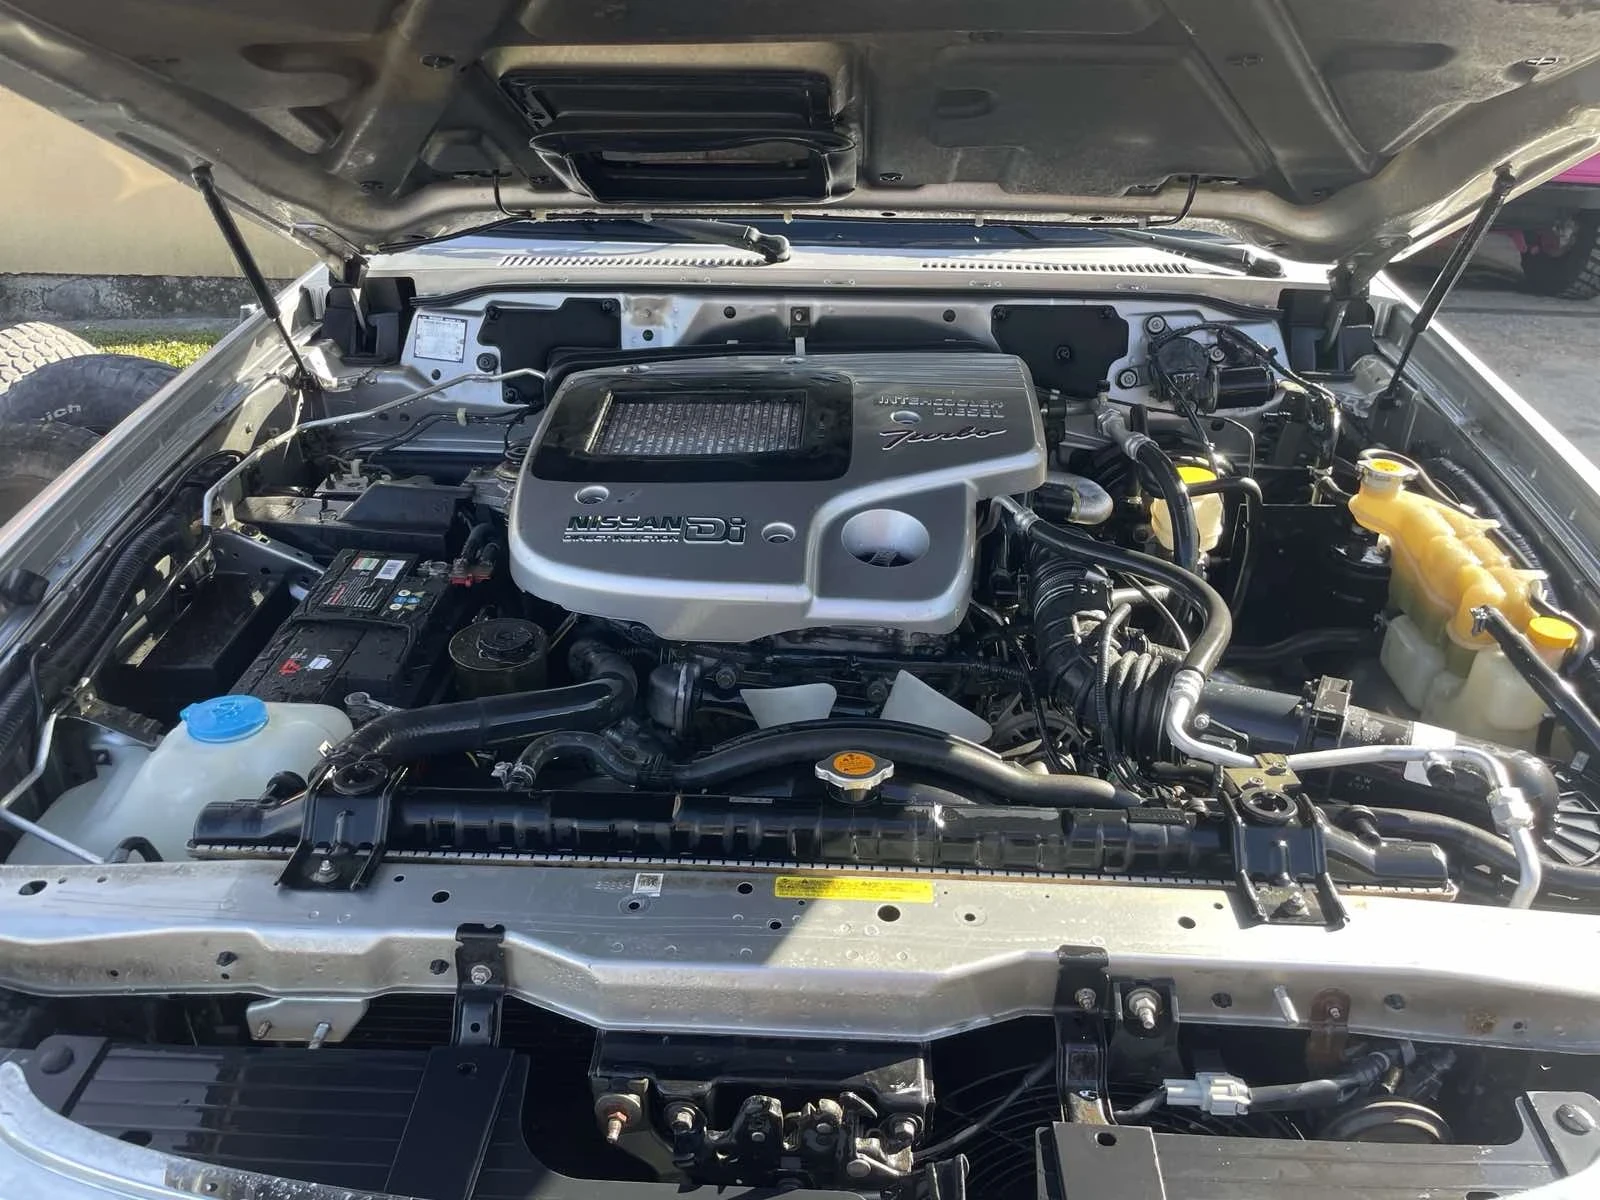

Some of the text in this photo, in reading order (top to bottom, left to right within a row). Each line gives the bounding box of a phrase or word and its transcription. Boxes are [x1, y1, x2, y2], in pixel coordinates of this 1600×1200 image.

[877, 395, 1005, 409] INTERCOOLER
[932, 407, 1005, 418] DIESEL
[879, 425, 1007, 450] Turbo
[565, 515, 747, 545] NISSAN Di
[562, 534, 680, 543] DIRECT INJECTION
